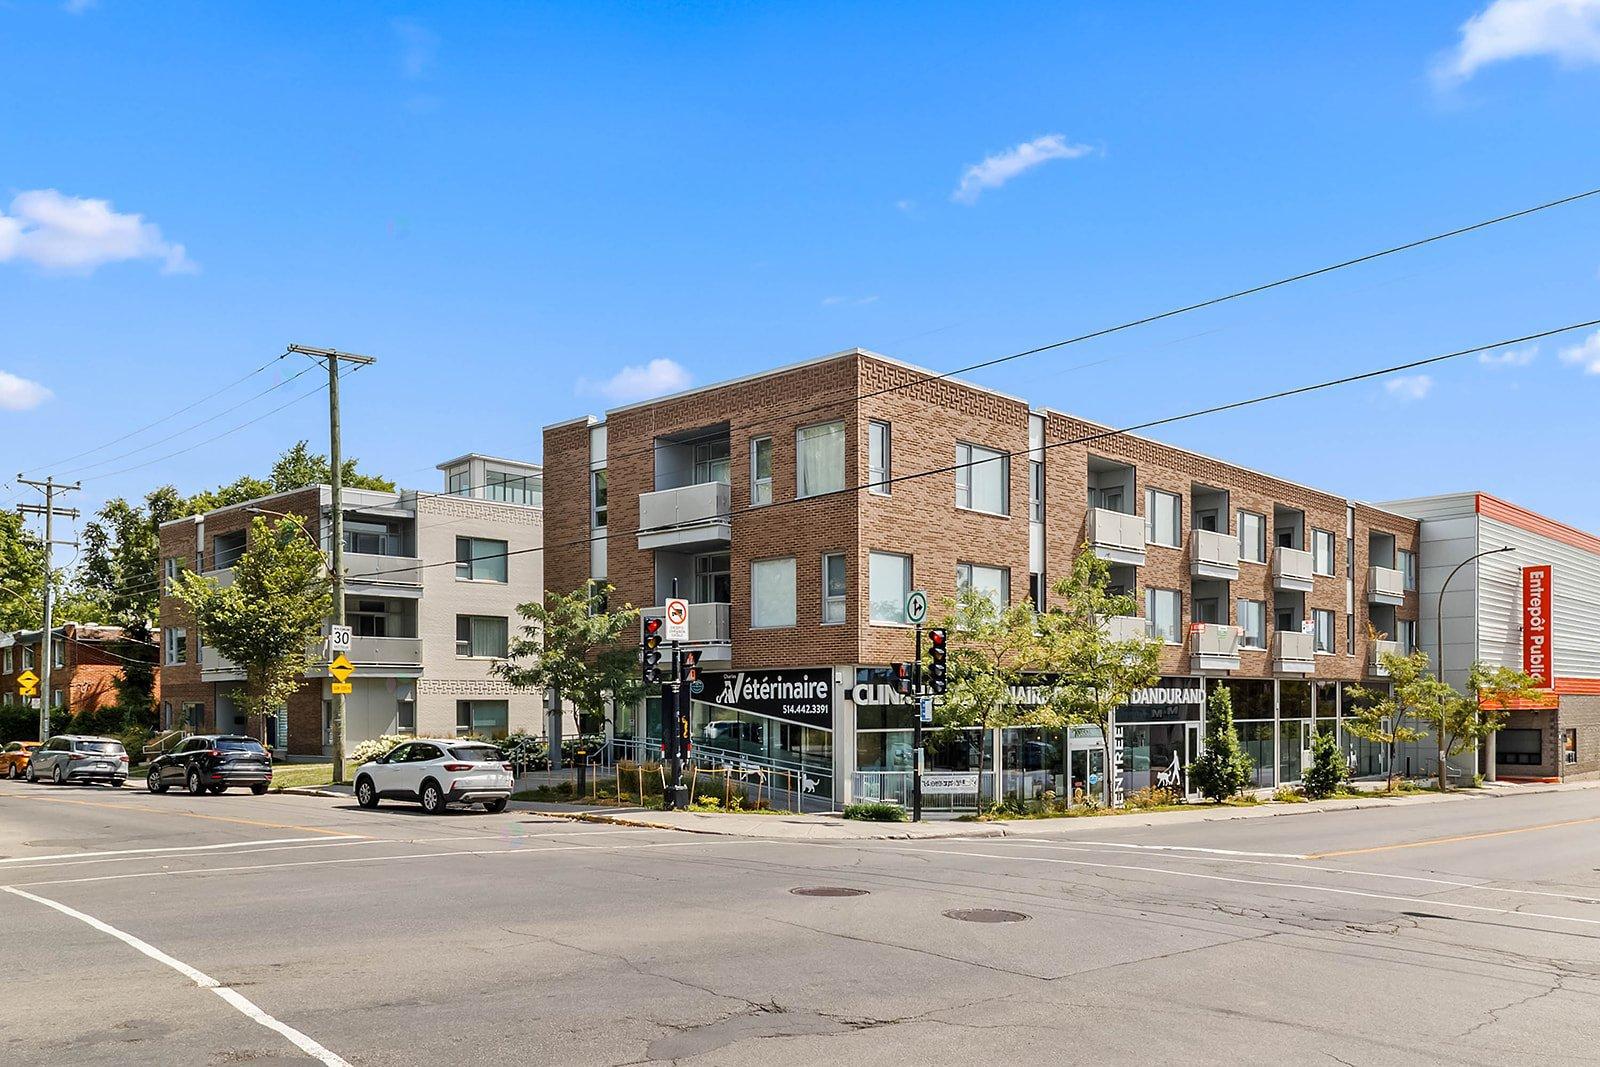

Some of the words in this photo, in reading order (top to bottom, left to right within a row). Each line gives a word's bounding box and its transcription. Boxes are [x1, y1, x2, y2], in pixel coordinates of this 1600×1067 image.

[1527, 571, 1546, 631] Entrepôt
[334, 631, 349, 645] 30
[1530, 635, 1545, 682] Public
[720, 673, 828, 704] Vétérinaire
[1131, 687, 1206, 704] DANDURAND
[783, 704, 829, 714] 514.442.3391
